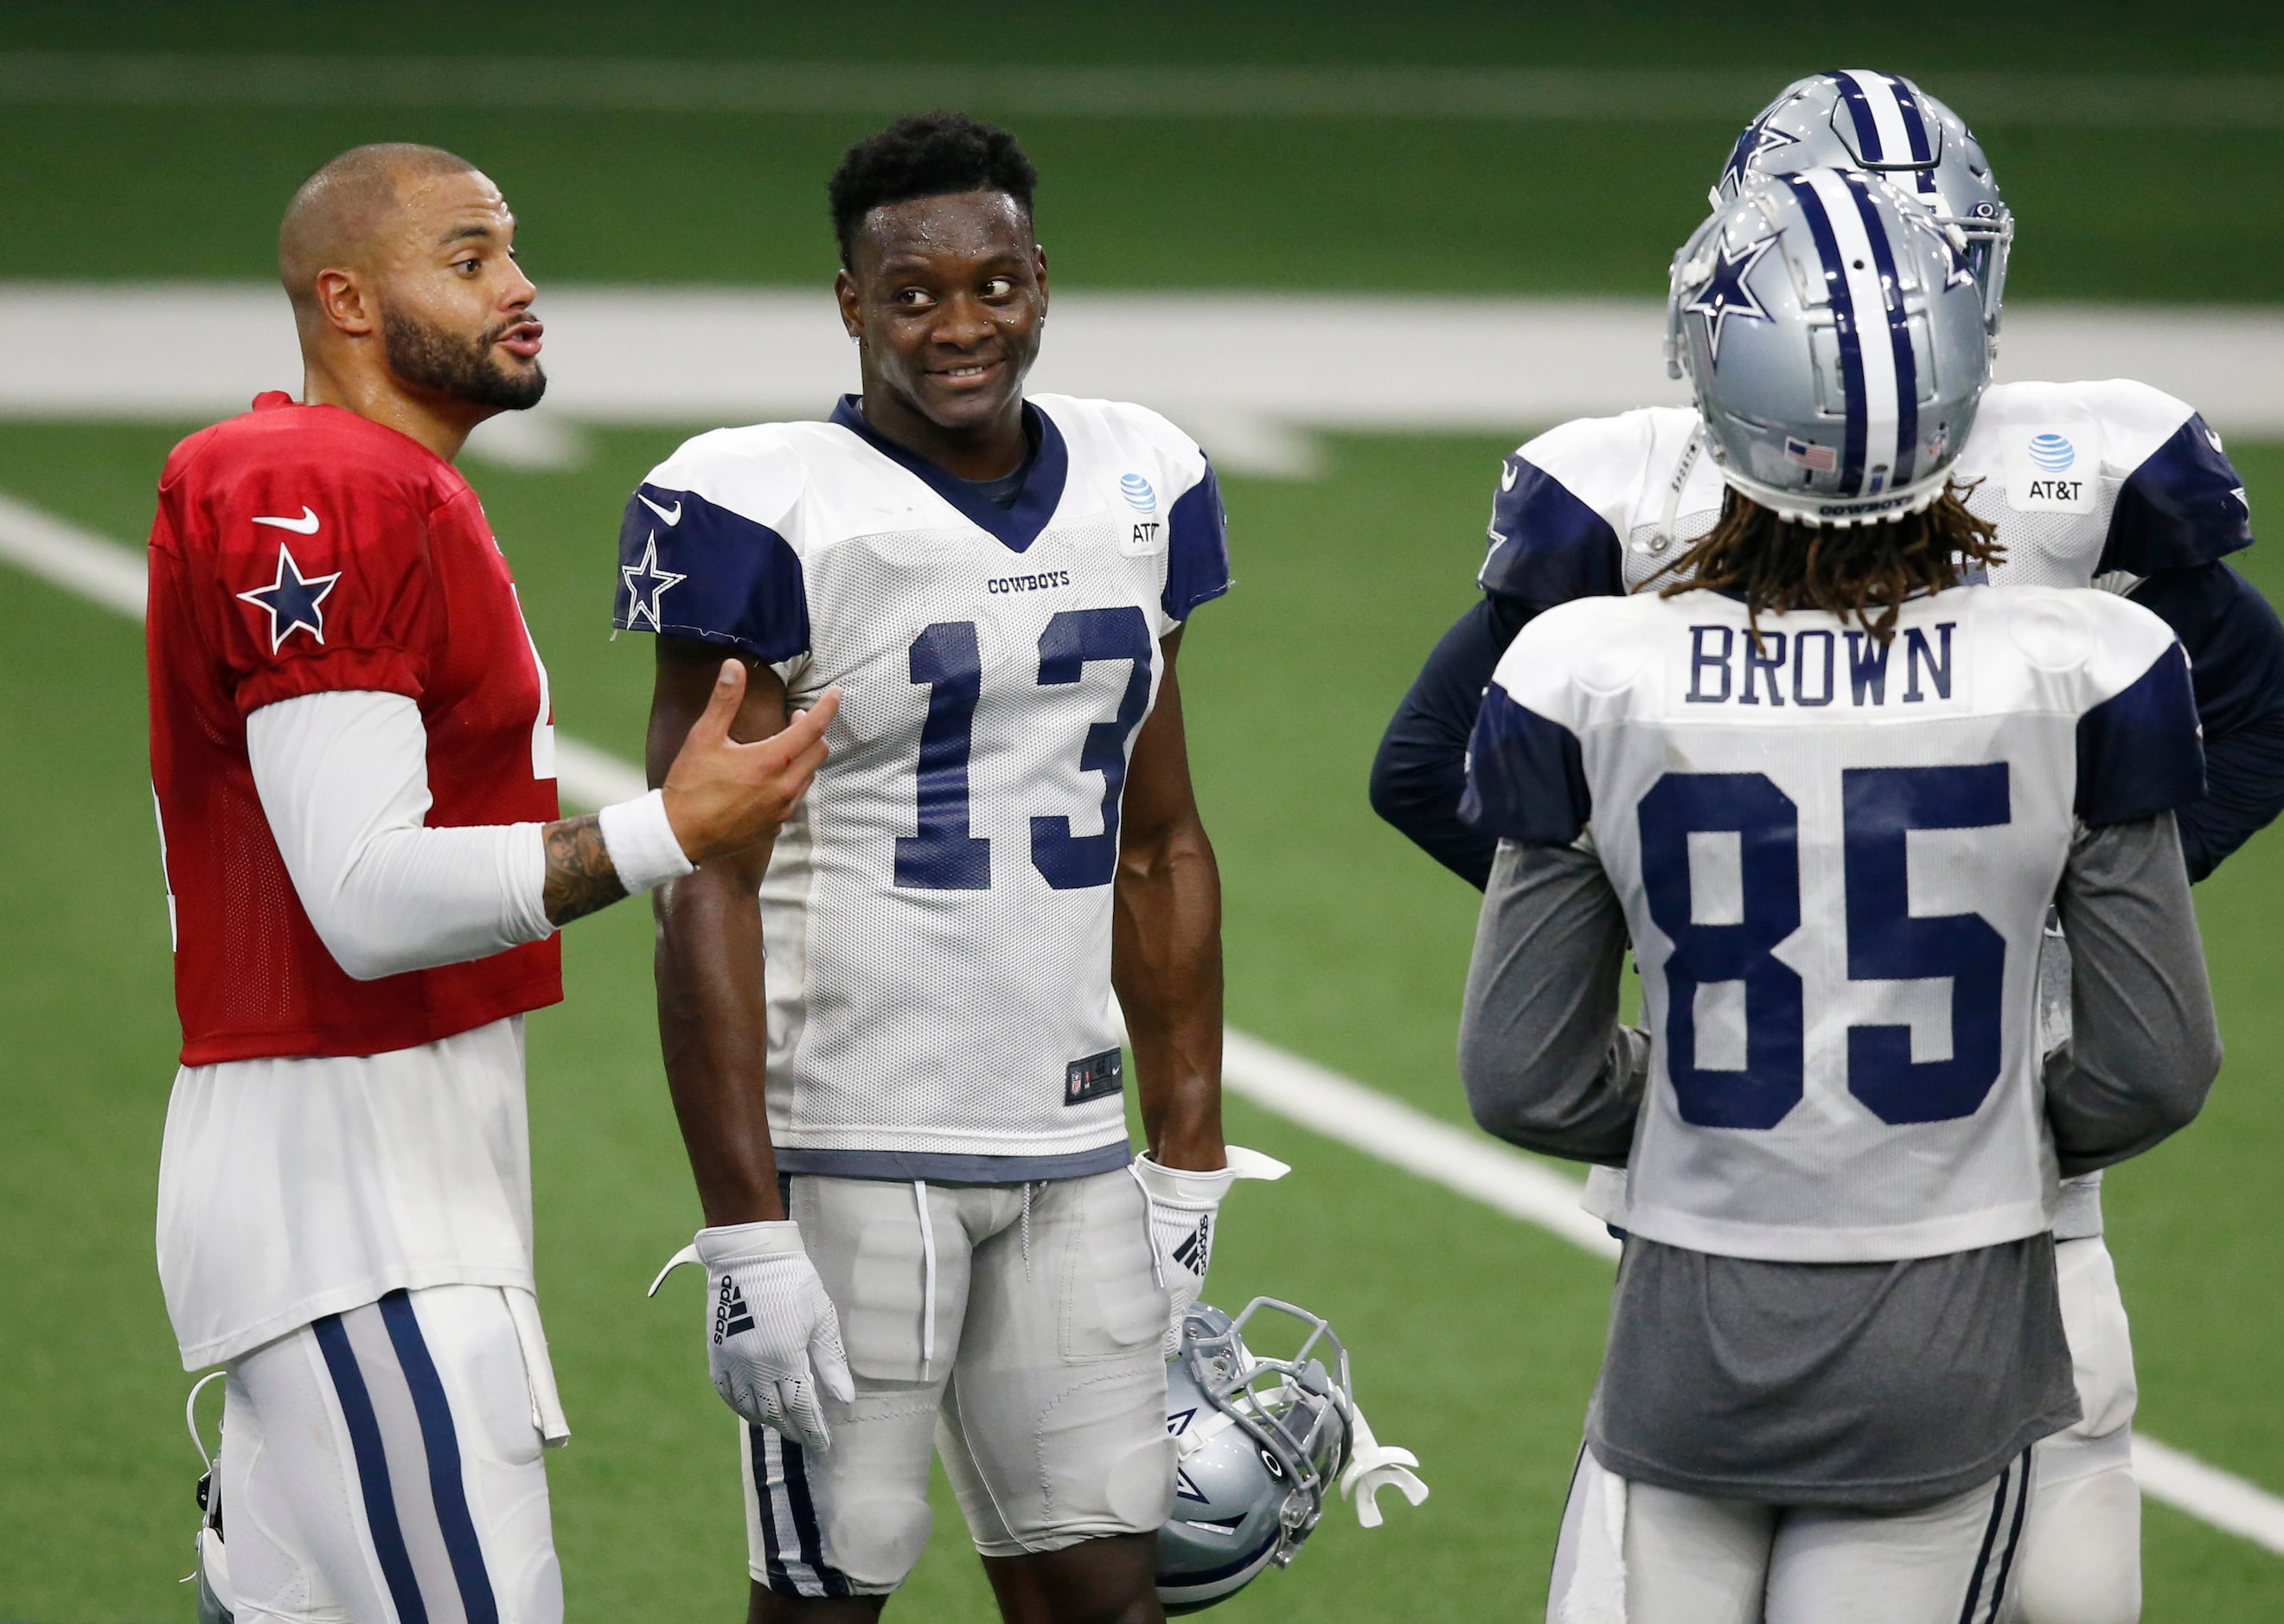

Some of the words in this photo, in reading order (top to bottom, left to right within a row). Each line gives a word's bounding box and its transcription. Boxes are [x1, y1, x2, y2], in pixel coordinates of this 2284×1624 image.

[2029, 481, 2082, 501] AT&T
[988, 571, 1070, 594] COWBOYS
[1685, 622, 1957, 707] BROWN
[893, 606, 1152, 890] 13
[1637, 762, 2011, 1130] 85
[1198, 1214, 1208, 1276] adidas
[713, 1275, 733, 1346] adidas
